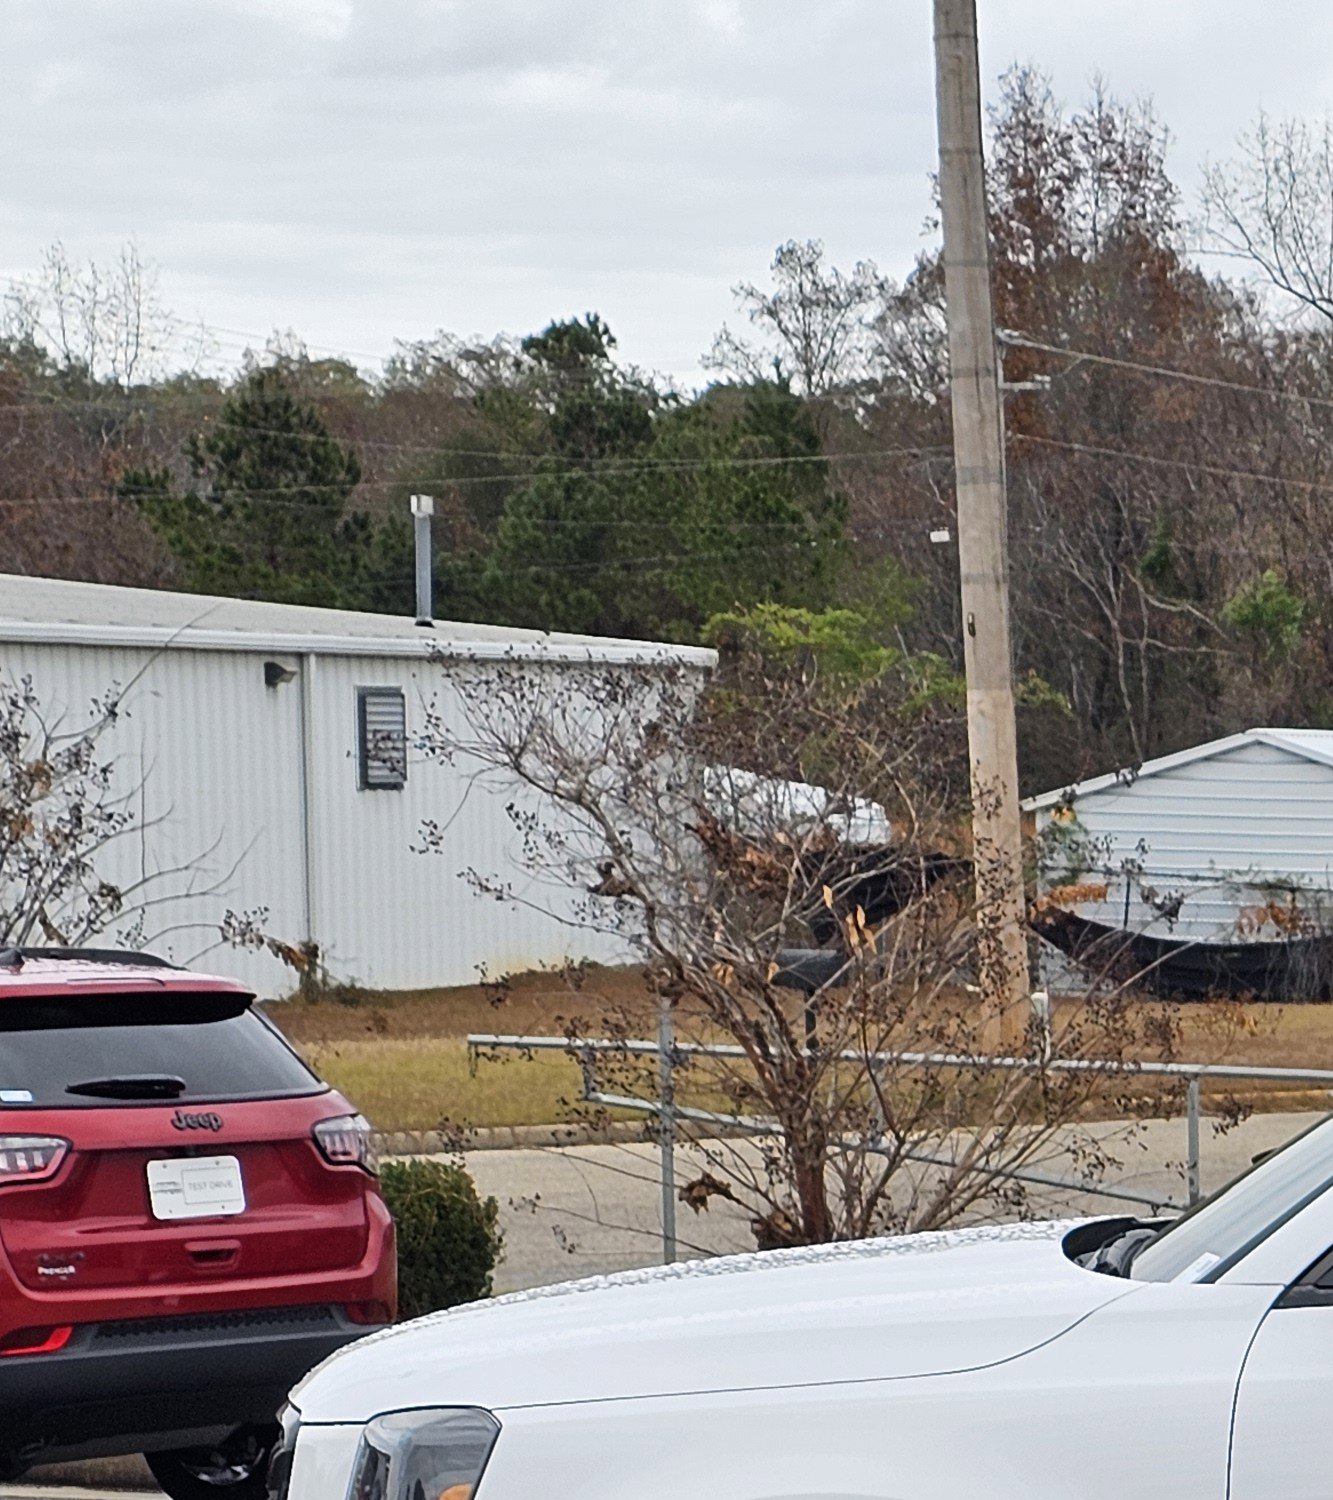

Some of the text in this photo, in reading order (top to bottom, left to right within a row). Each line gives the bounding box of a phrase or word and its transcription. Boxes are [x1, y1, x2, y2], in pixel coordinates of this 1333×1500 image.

[171, 1109, 225, 1133] Jeep
[188, 1182, 207, 1191] TEST
[209, 1180, 233, 1190] DRIVE
